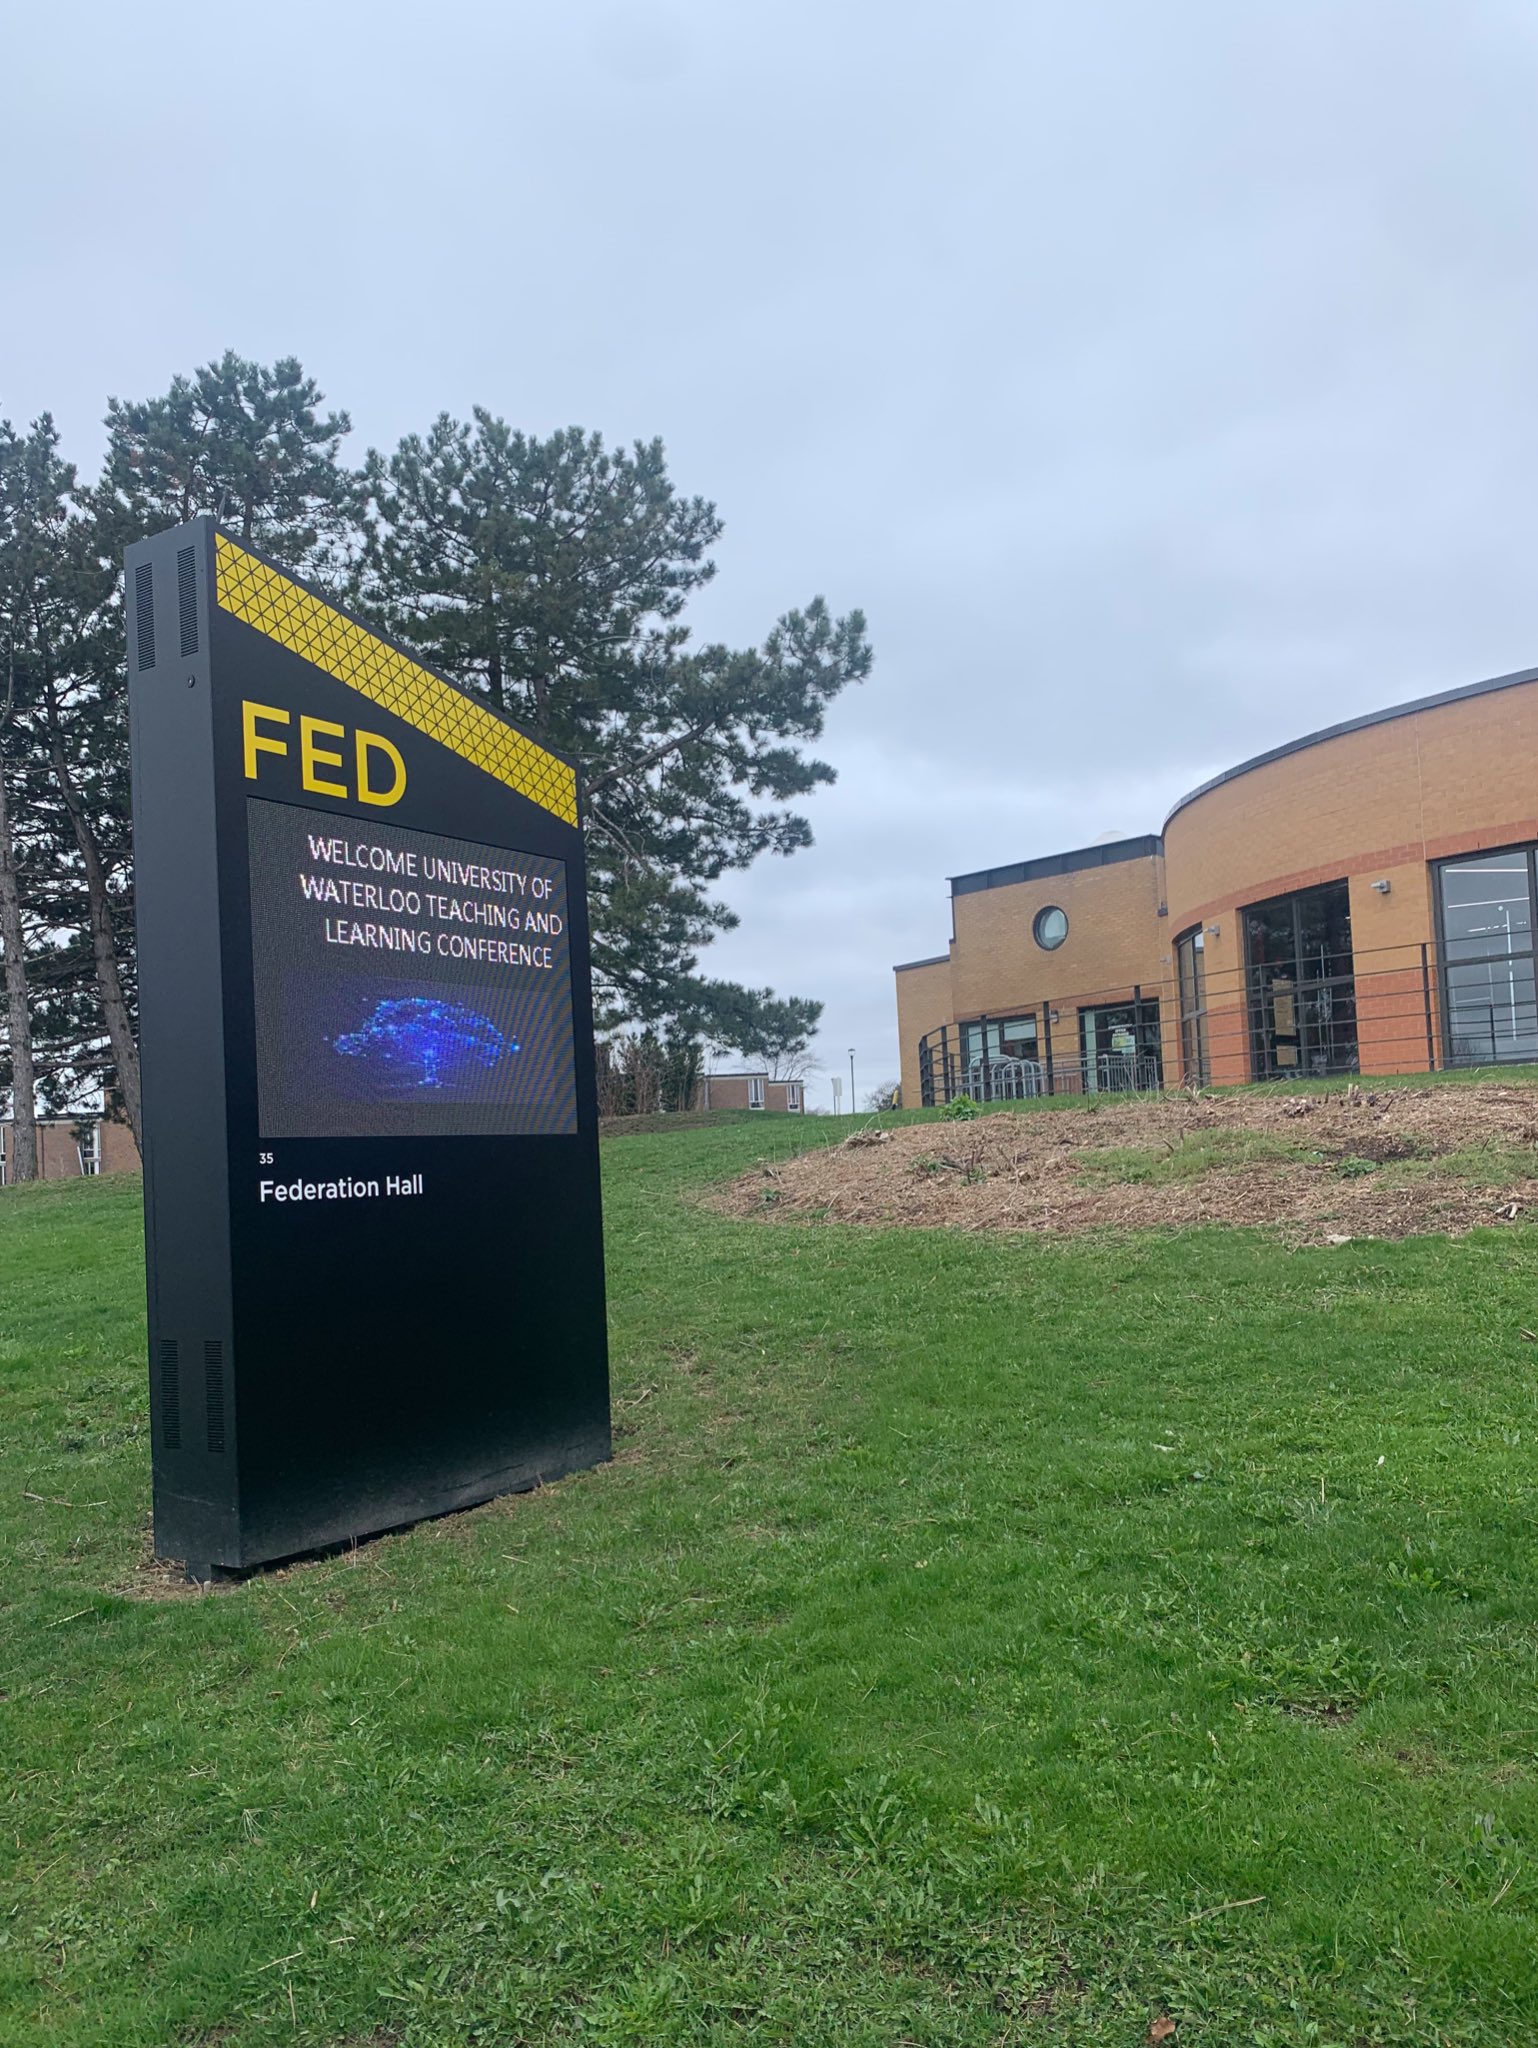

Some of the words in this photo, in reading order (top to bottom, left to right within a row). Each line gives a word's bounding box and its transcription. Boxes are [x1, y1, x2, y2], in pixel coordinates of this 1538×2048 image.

[242, 700, 407, 806] FED
[308, 834, 417, 877] WELCOME
[423, 855, 527, 895] UNIVERSITY
[531, 876, 552, 900] OF
[300, 873, 421, 915] WATERLOO
[425, 893, 520, 930] TEACHING
[524, 911, 562, 936] AND
[326, 918, 431, 954] LEARNING
[437, 933, 553, 969] CONFERENCE
[259, 1153, 274, 1164] 35
[260, 1177, 379, 1202] Federation
[386, 1174, 423, 1196] Hall
